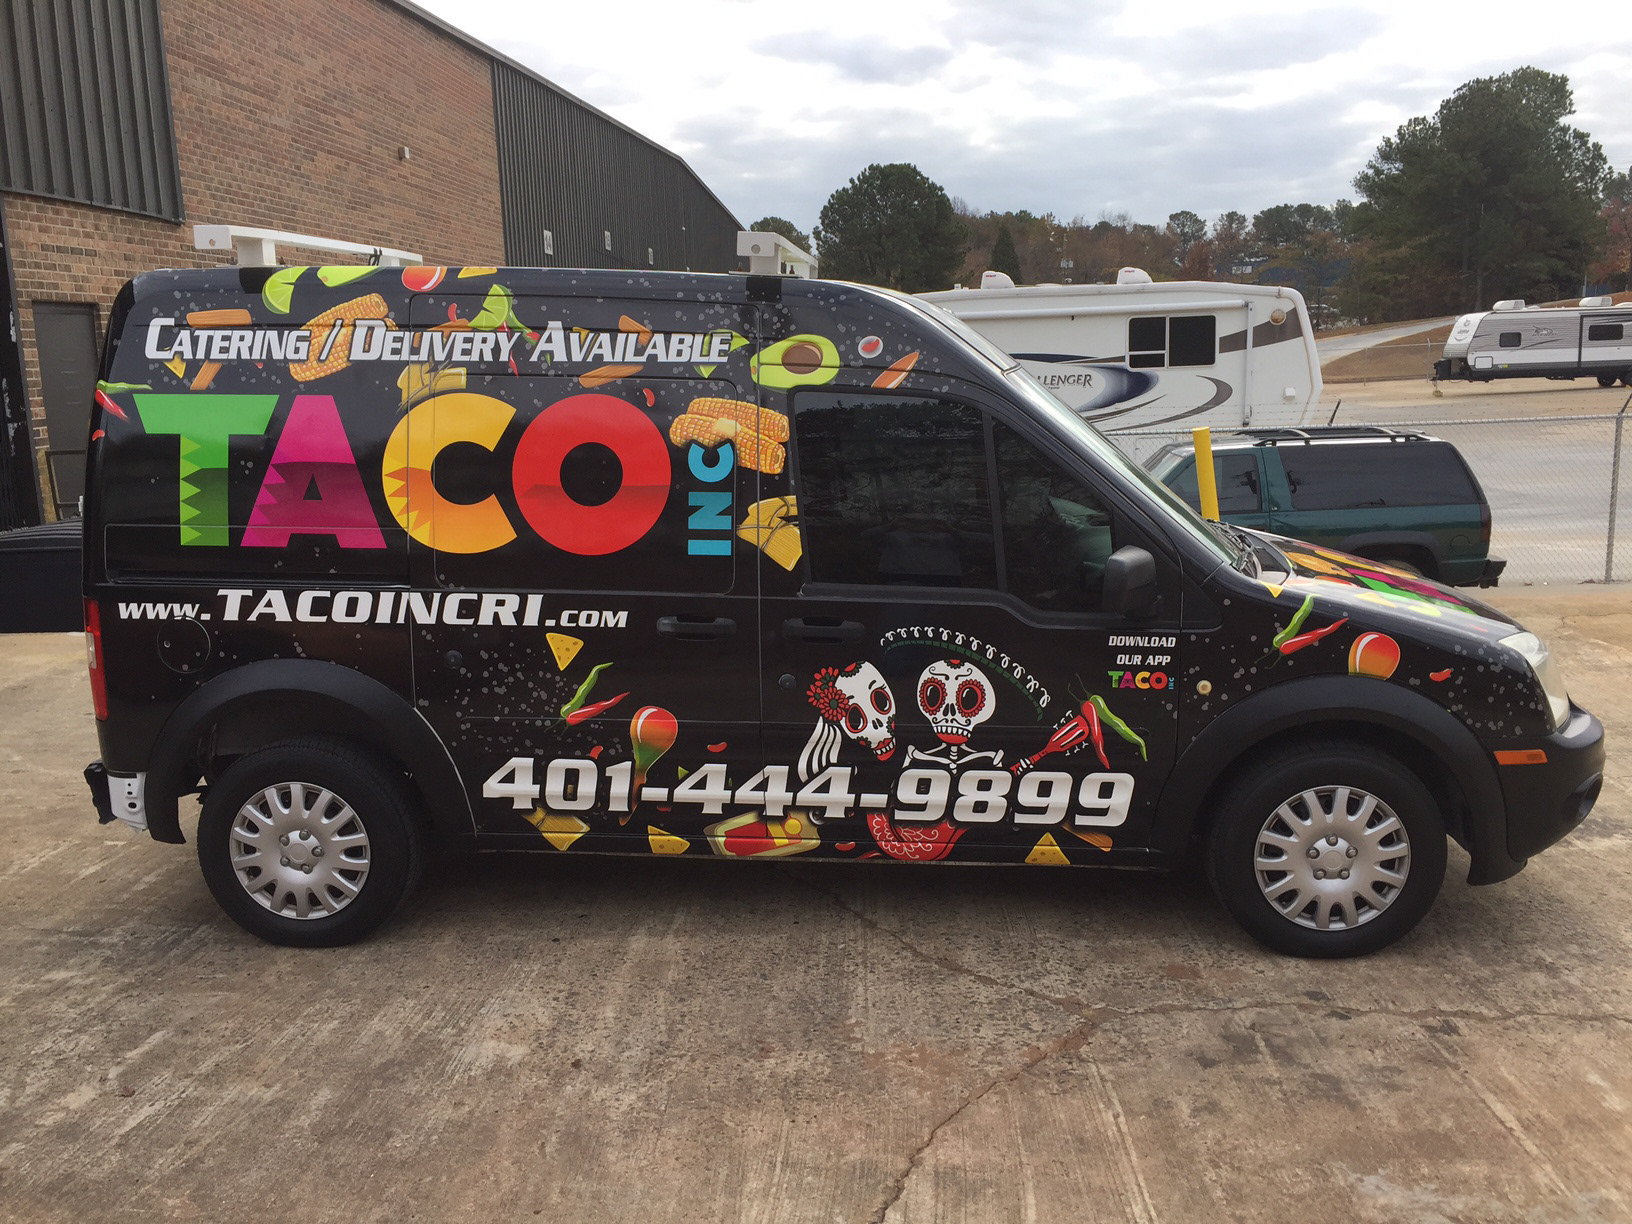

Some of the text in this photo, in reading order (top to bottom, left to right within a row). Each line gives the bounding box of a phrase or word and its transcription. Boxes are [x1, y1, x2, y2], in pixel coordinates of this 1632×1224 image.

[320, 320, 342, 360] /
[1037, 374, 1093, 388] LENGER
[132, 392, 672, 556] TACO
[687, 442, 735, 556] INC
[1108, 636, 1176, 647] DOWNLOAD
[1116, 654, 1171, 665] OUR APP
[1107, 671, 1168, 690] TACO
[482, 756, 1135, 827] 401-444-9899
